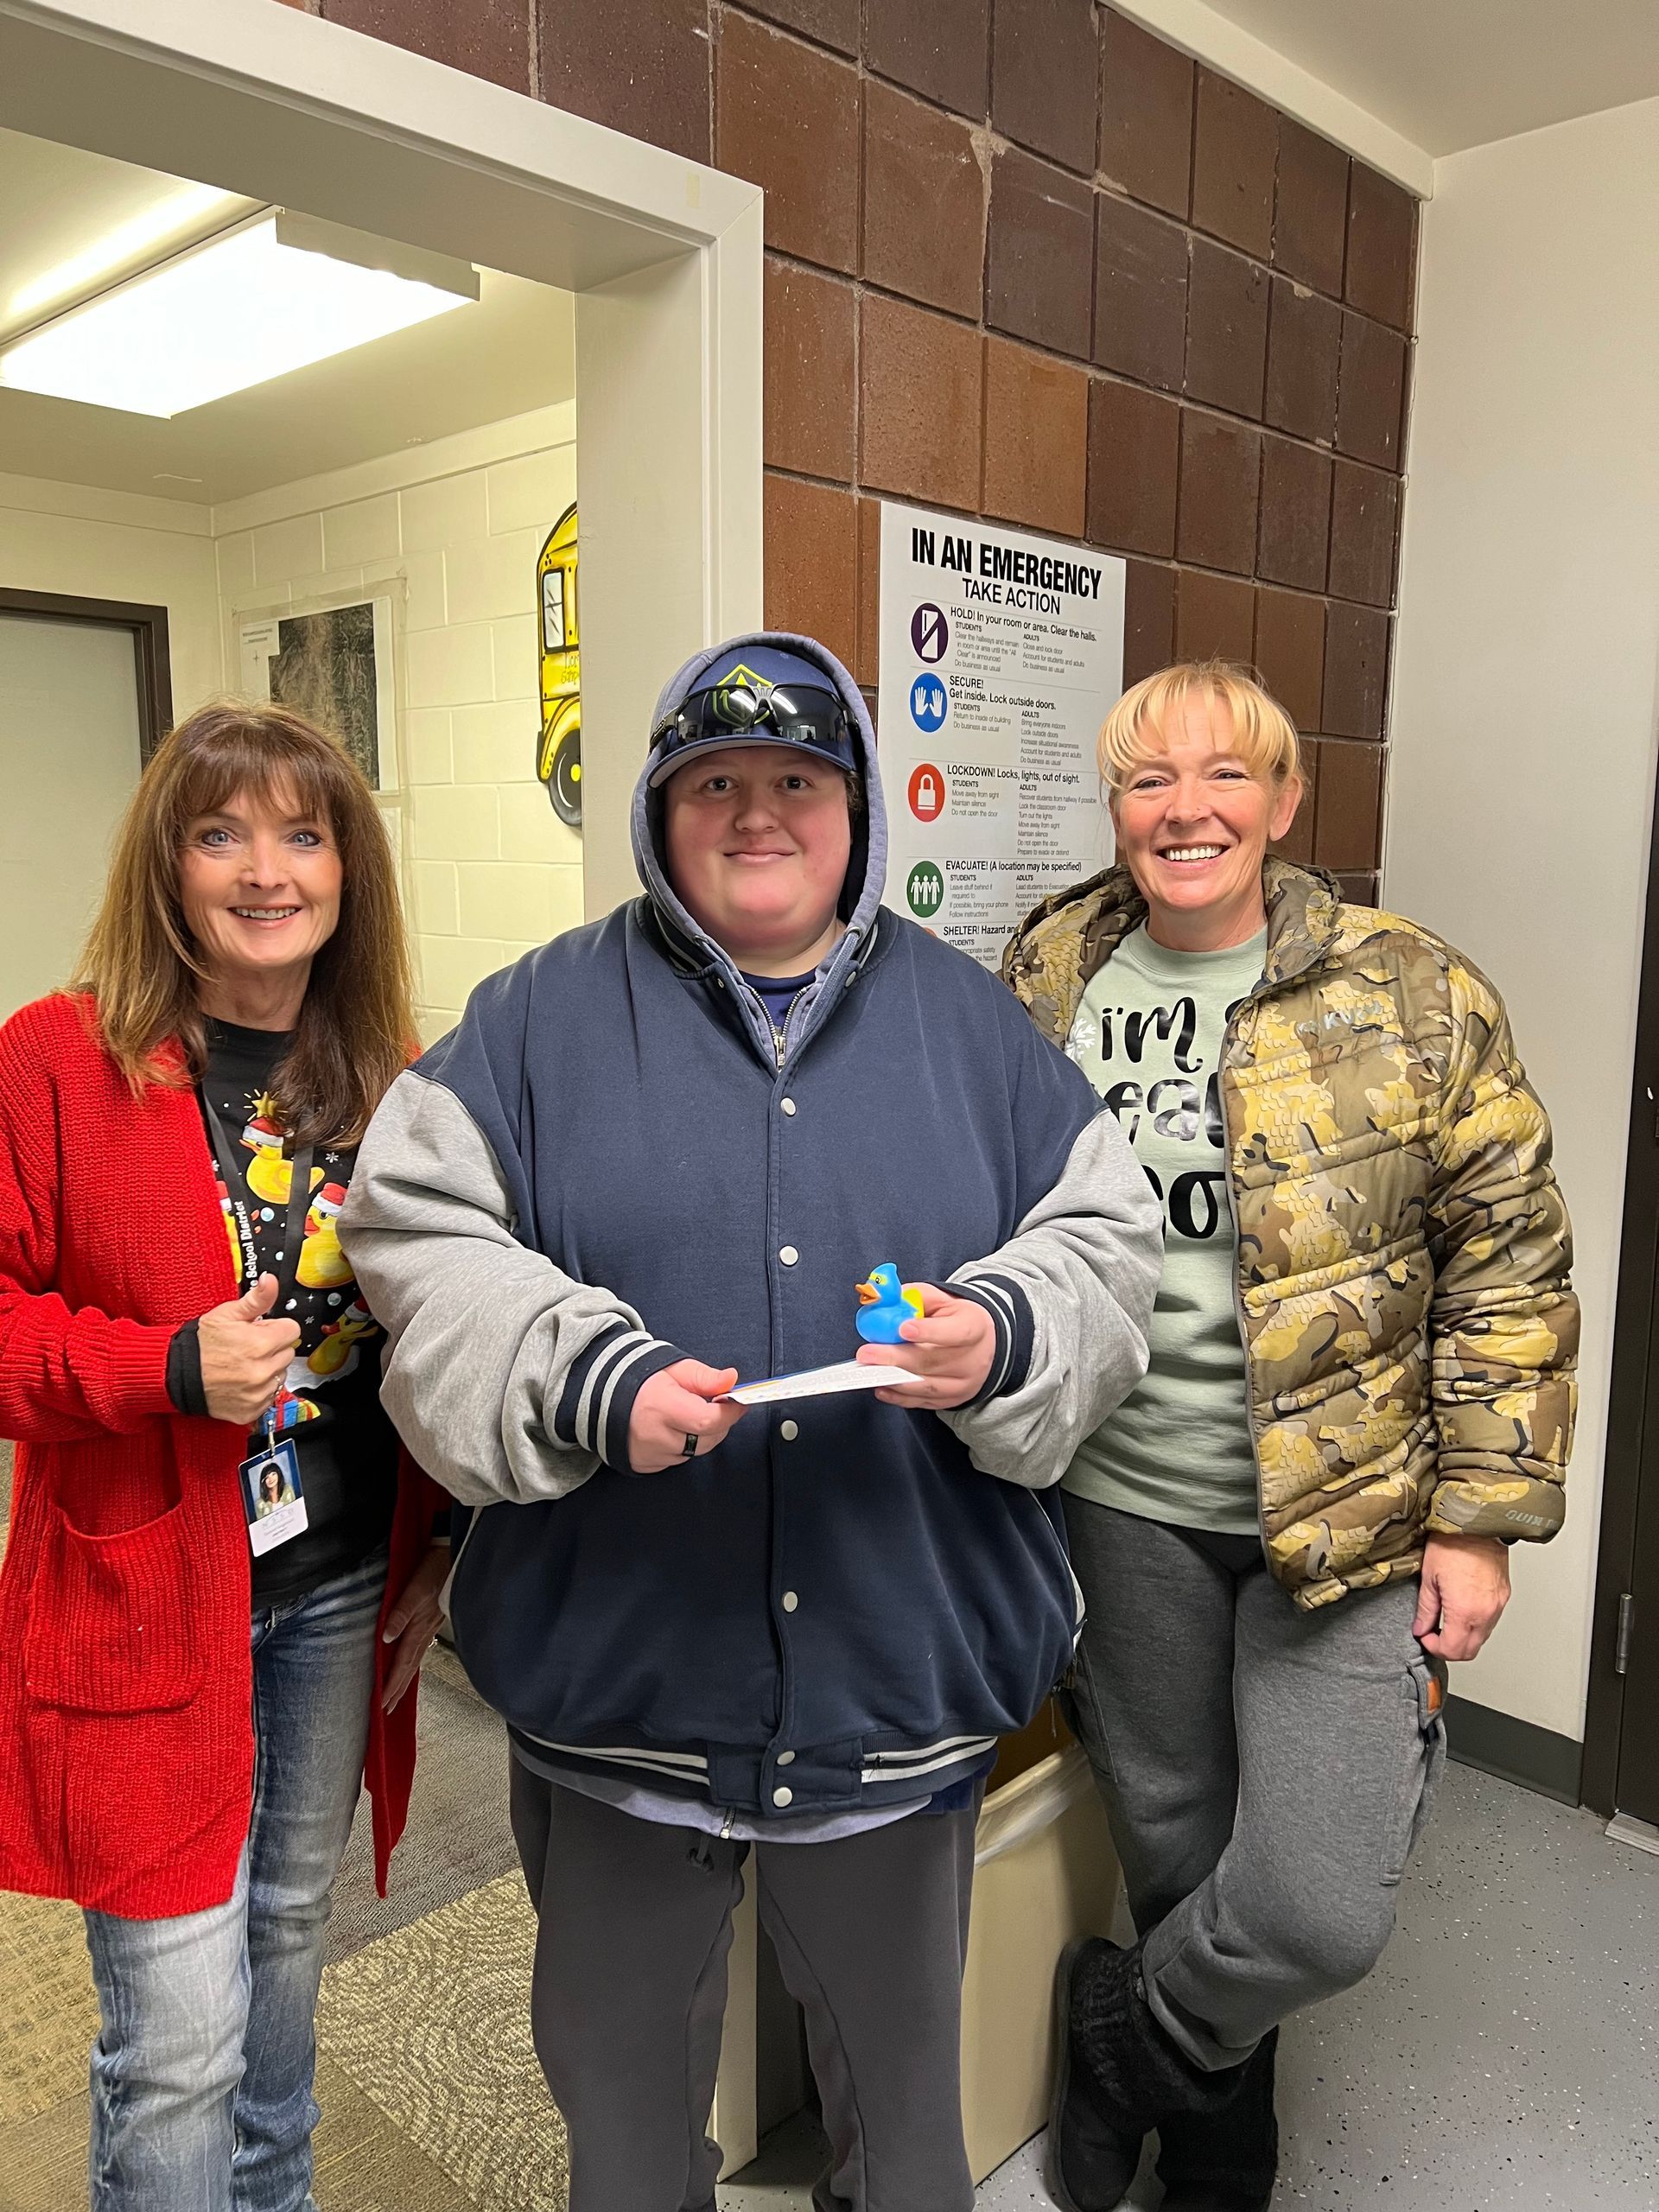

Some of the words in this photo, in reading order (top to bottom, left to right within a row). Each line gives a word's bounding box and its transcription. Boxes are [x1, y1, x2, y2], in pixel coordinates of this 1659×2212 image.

[912, 528, 934, 565] IN
[941, 535, 971, 573] AN
[980, 543, 1101, 599] EMERGENCY
[963, 578, 1002, 603] TAKE
[1005, 587, 1060, 615] ACTION
[951, 606, 975, 620] HOLD!
[977, 611, 983, 622] In
[986, 615, 1002, 624] your
[1004, 618, 1021, 628] room
[1032, 624, 1048, 633] area.
[1051, 625, 1068, 636] Clear
[1069, 629, 1079, 638] the
[1081, 630, 1096, 641] halls.
[956, 622, 982, 632] STUDENTS
[950, 676, 983, 689] SECURE!
[950, 688, 962, 698] Get
[964, 690, 987, 702] inside.
[990, 693, 1007, 704] Lock
[1009, 696, 1034, 707] outside
[1036, 699, 1056, 710] doors.
[954, 702, 980, 712] STUDENTS
[948, 765, 995, 777] LOCKDOWN!
[997, 768, 1020, 780] Locks,
[1022, 770, 1041, 782] lights,
[1042, 773, 1053, 781] out
[1063, 774, 1079, 785] sight.
[946, 860, 988, 870] EVACUATE!
[990, 861, 997, 872] (A
[999, 861, 1025, 870] location
[1027, 864, 1040, 872] may
[1042, 862, 1049, 870] be
[1051, 862, 1081, 872] specified)
[943, 925, 979, 936] SHELTER!
[981, 924, 1005, 934] Hazard
[1102, 997, 1203, 1073] i'm
[234, 1201, 252, 1240] District
[242, 1241, 258, 1278] School
